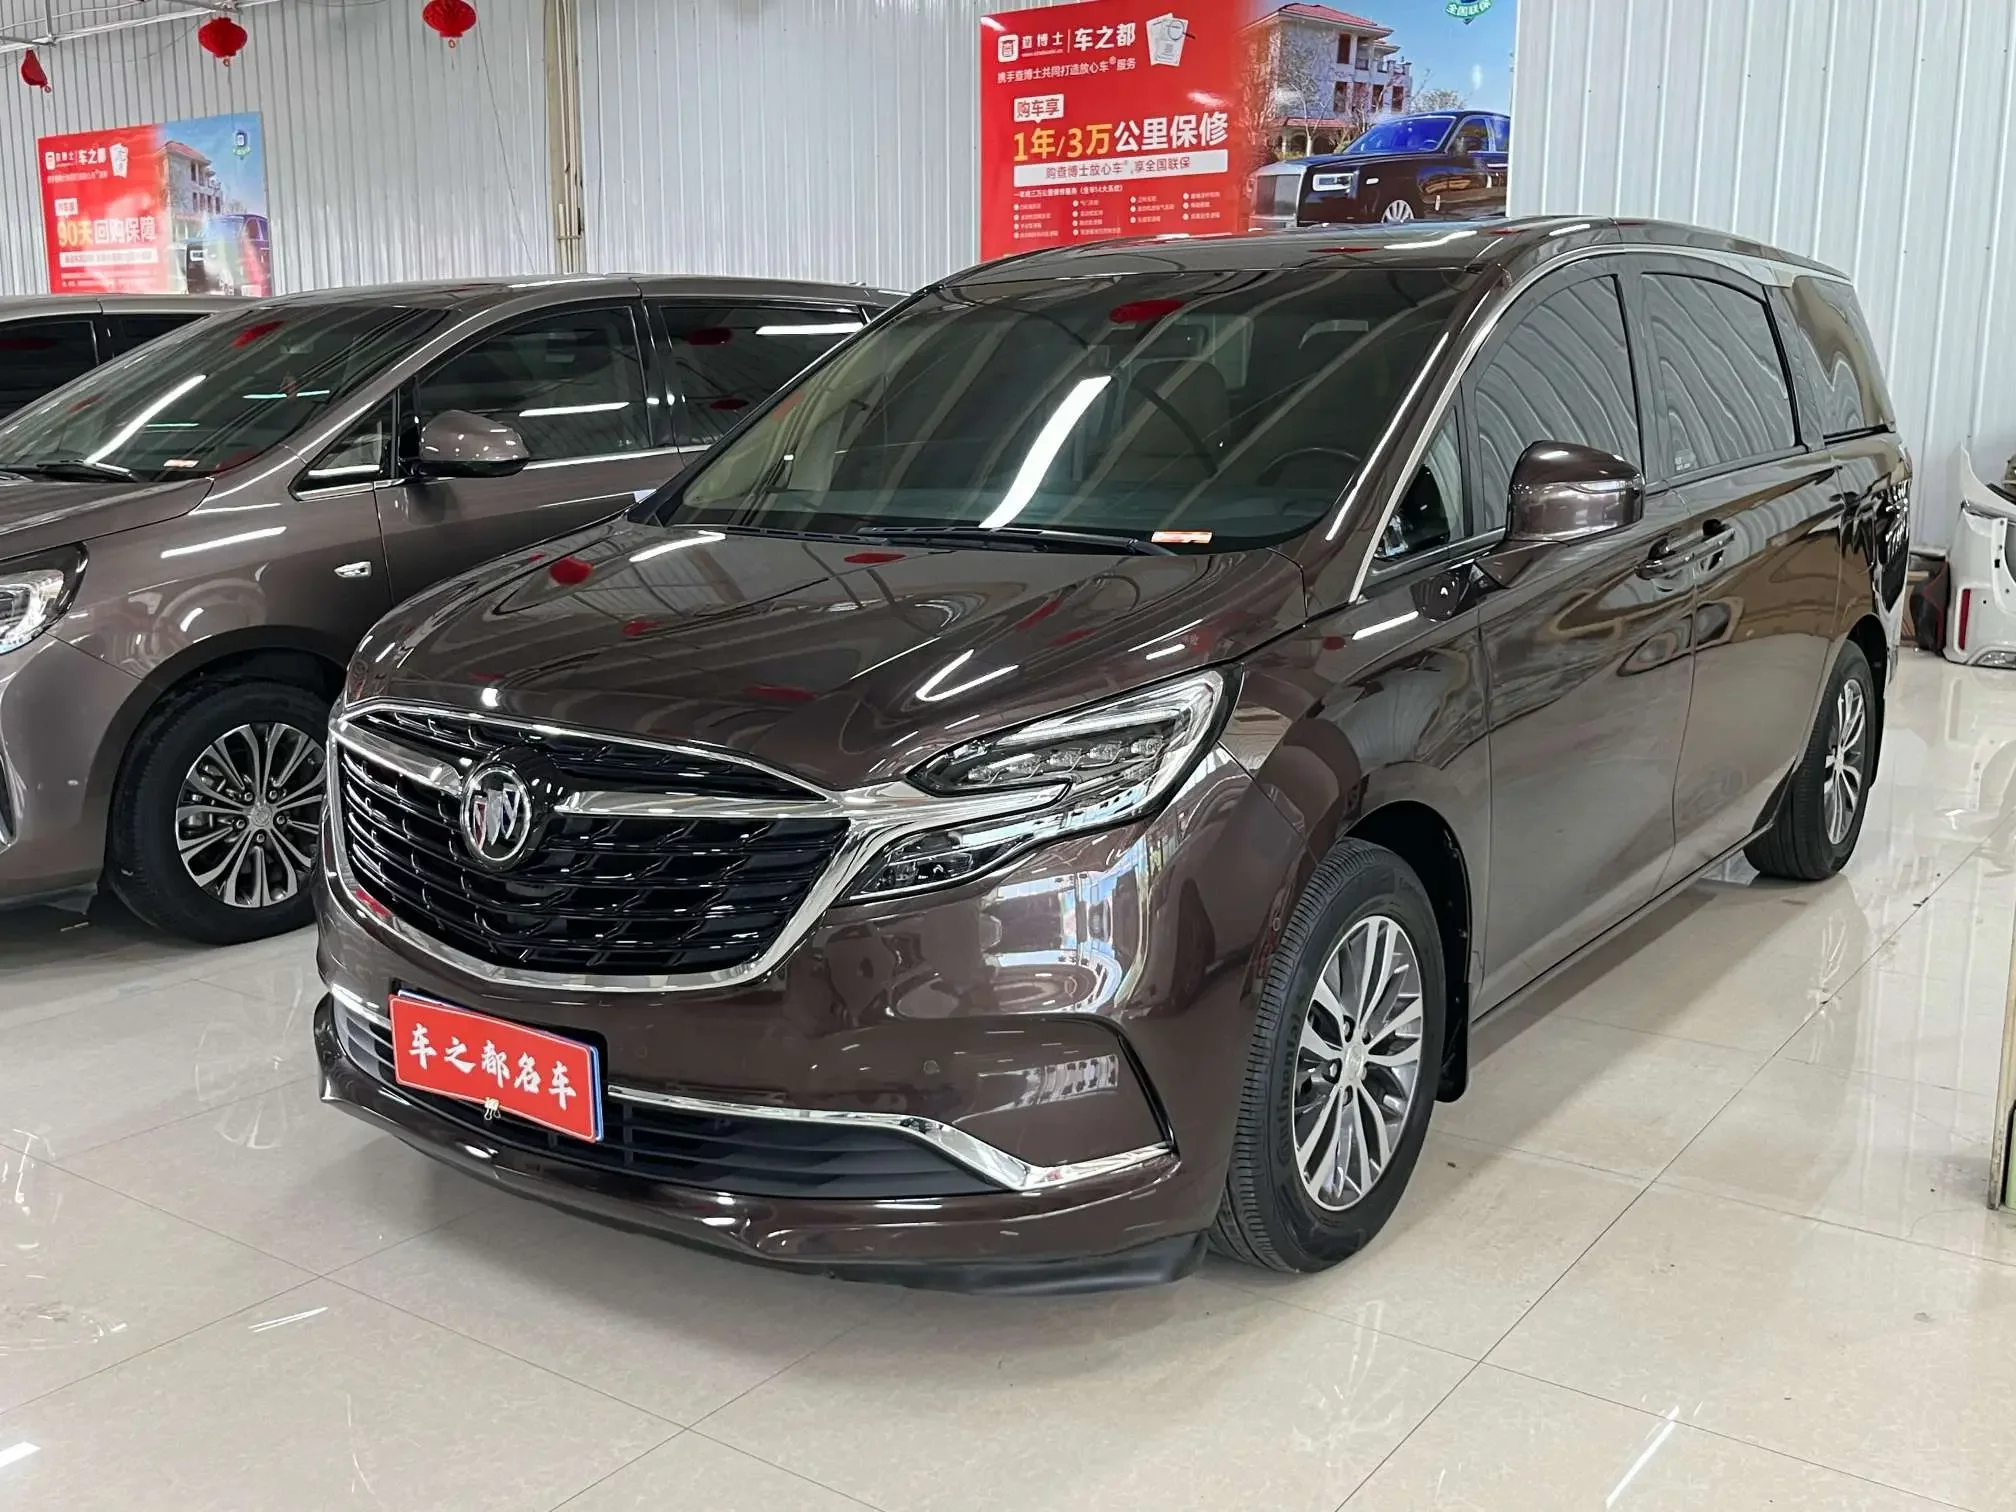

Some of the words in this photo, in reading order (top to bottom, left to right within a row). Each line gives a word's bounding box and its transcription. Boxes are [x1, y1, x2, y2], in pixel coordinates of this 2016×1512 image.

[1074, 22, 1136, 51] 车之都
[1016, 98, 1060, 118] 购车享
[1013, 112, 1229, 161] 1年/3万公里保修
[408, 1022, 577, 1111] 车之都名车
